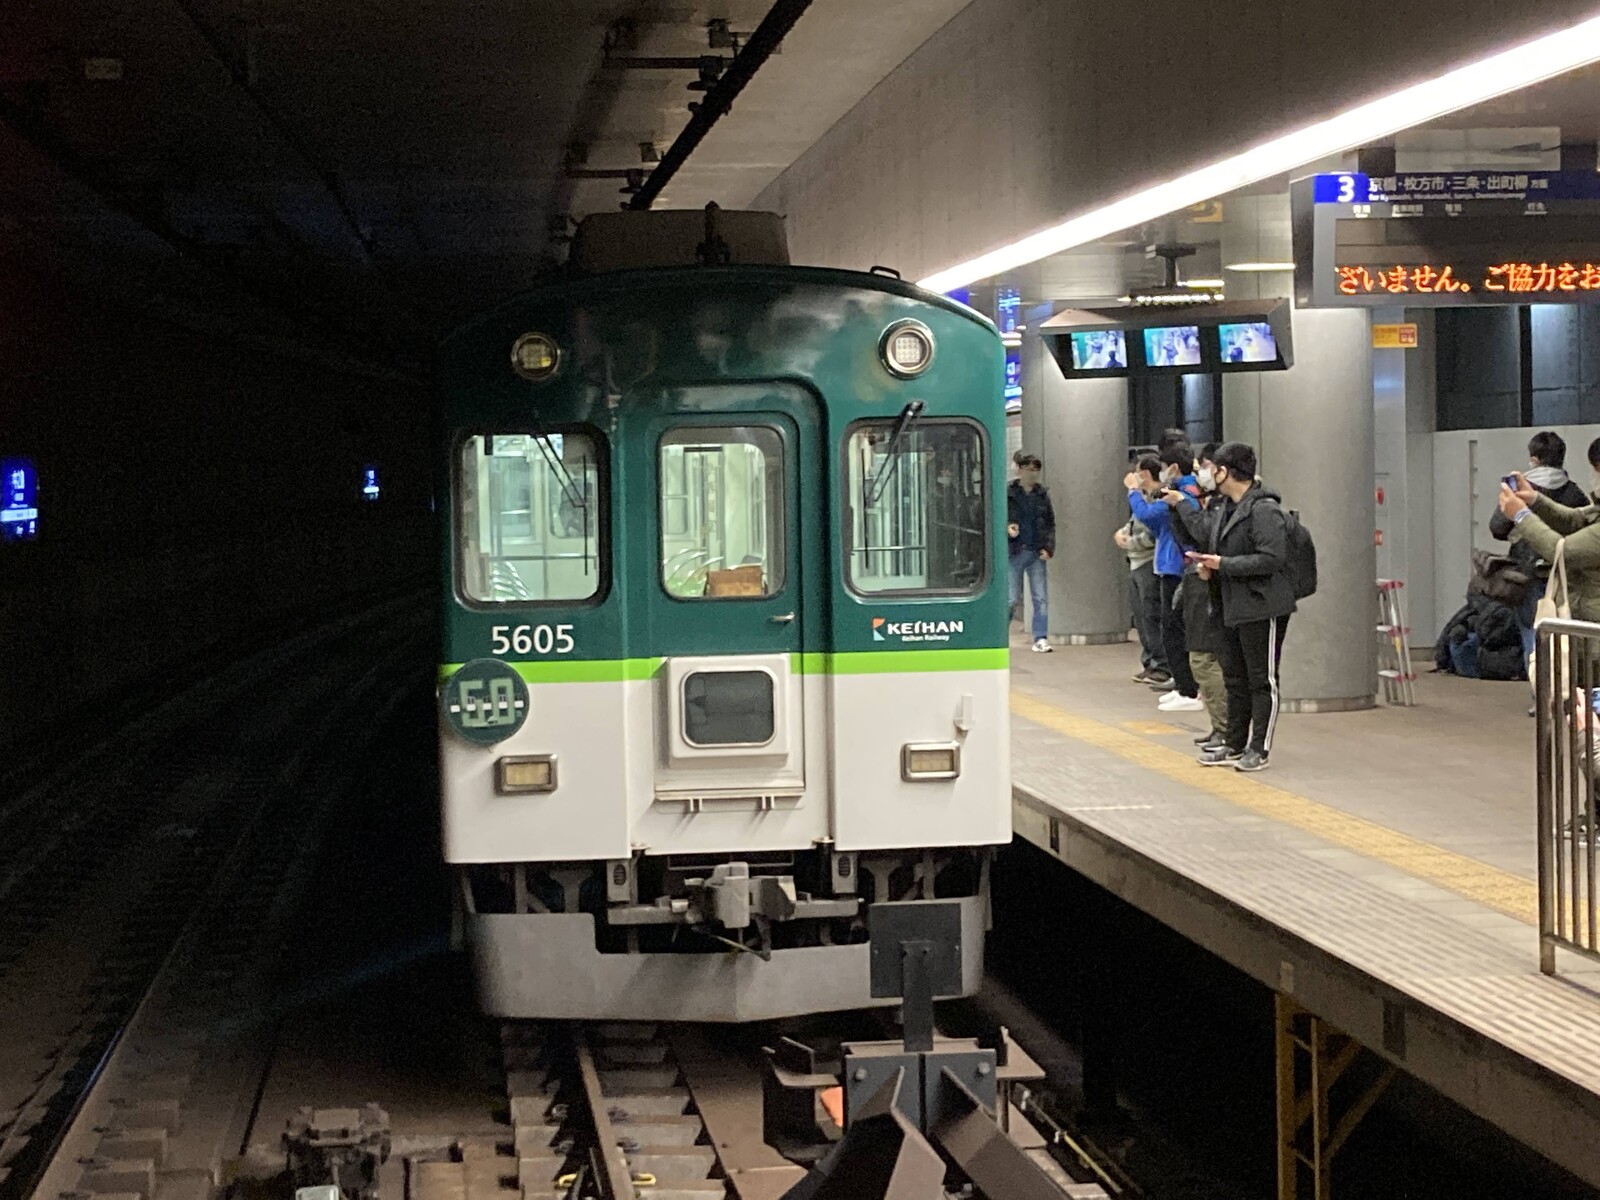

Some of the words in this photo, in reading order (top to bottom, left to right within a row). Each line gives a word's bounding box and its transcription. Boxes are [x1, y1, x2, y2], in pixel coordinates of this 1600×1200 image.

[1337, 176, 1355, 202] 3
[1334, 264, 1471, 294] ざいません。
[1485, 263, 1600, 291] ご協力をお
[491, 624, 575, 655] 5605
[887, 620, 964, 635] KEIHAN
